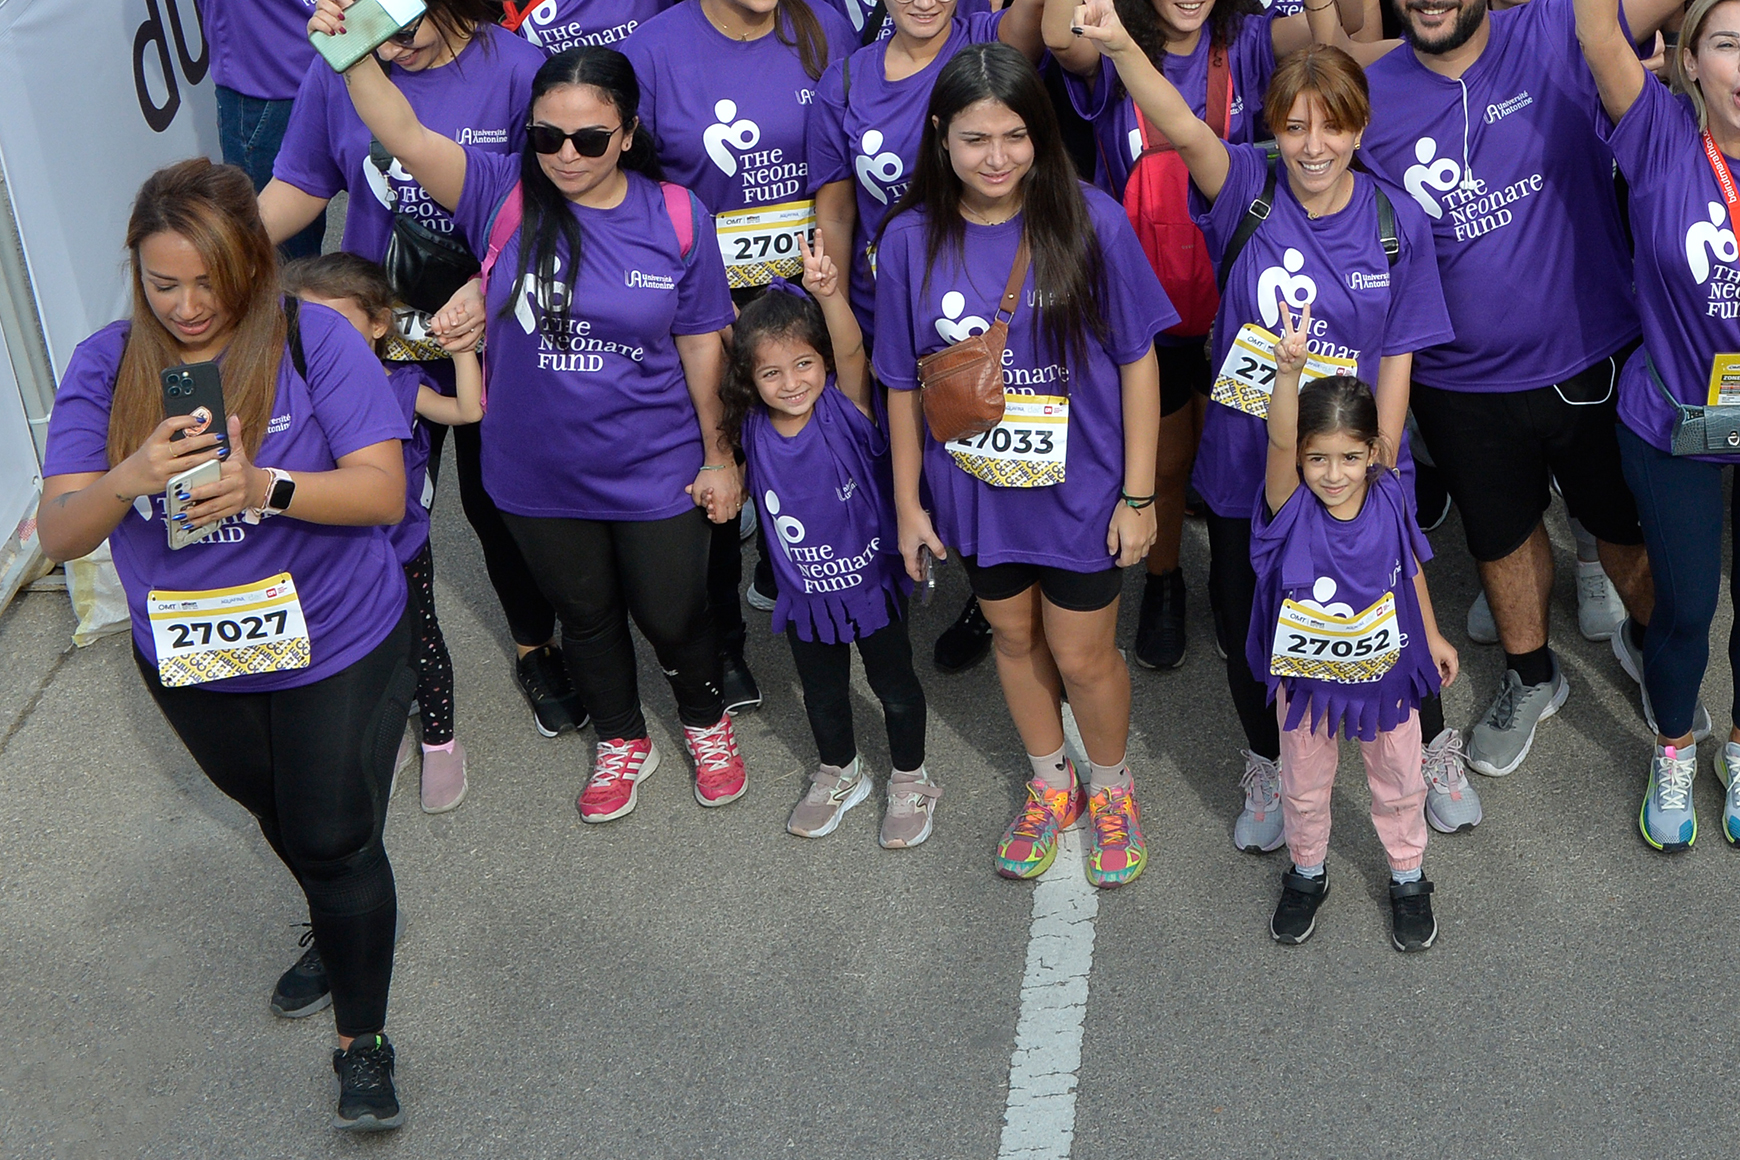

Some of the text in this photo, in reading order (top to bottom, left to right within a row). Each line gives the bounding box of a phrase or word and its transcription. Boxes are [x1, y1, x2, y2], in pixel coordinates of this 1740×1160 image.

[1498, 90, 1529, 112] Université
[1500, 97, 1534, 120] Antonine
[473, 127, 507, 137] Université
[473, 135, 508, 144] Antonine
[725, 216, 743, 226] OMT
[642, 273, 673, 283] Université
[643, 280, 675, 290] Antonine
[1247, 335, 1265, 348] OMT
[158, 602, 177, 611] OMT
[1290, 612, 1306, 623] OMT
[166, 609, 289, 649] 27027
[1287, 628, 1391, 658] 27052
